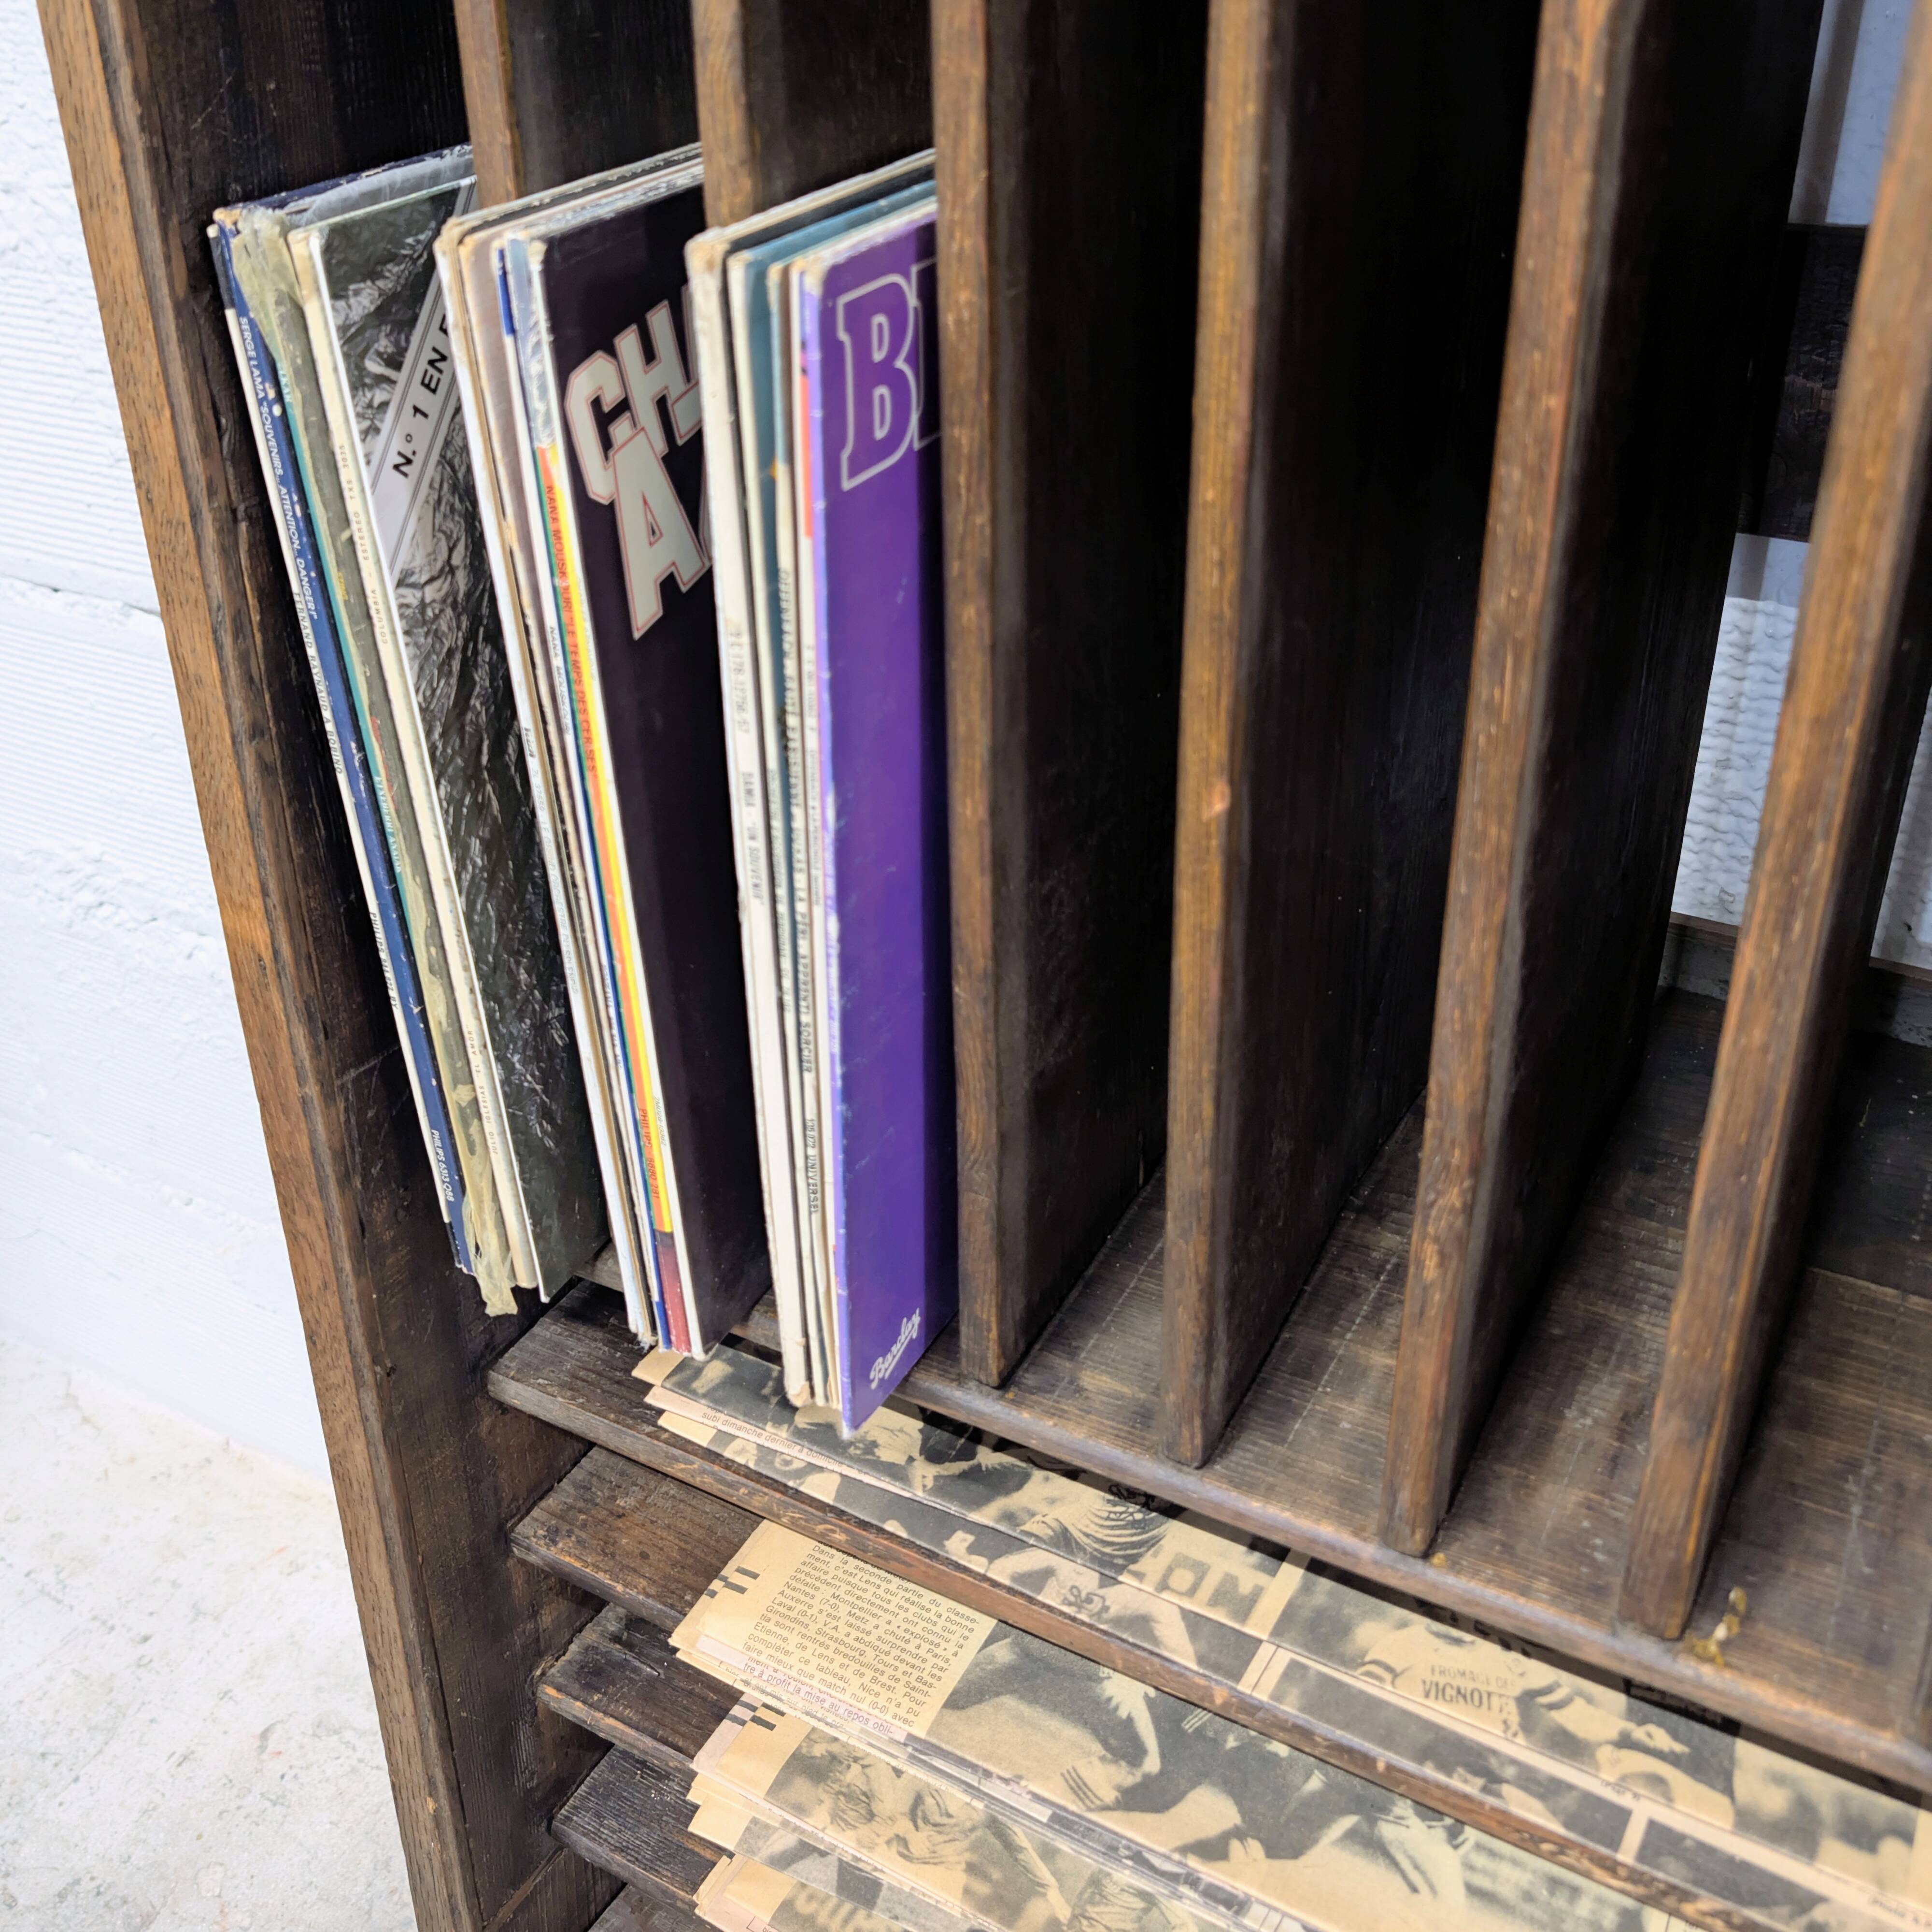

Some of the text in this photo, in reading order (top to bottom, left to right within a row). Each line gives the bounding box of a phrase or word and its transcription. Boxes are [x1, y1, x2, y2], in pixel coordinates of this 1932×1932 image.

[412, 404, 429, 420] 1
[421, 346, 448, 396] EN
[239, 315, 256, 357] SERGE
[249, 359, 266, 399] LAMA
[278, 485, 302, 557] ATTENTION...
[295, 557, 317, 620] DANGER!"
[339, 444, 388, 645] COLUMBIA ESTEREO TXS 3035
[612, 425, 712, 640] A
[545, 485, 559, 523] NANA
[569, 643, 583, 687] TEMPS
[576, 690, 587, 715] DES
[292, 591, 344, 774] FERNAND RAYNAUD A BOBINO
[549, 626, 560, 658] NANA
[369, 911, 385, 954] PHILIPS
[800, 1021, 812, 1073] SORCIER
[478, 1085, 492, 1124] IGLESIAS
[488, 1131, 498, 1155] JULIO
[431, 1128, 445, 1162] PHILIPS
[439, 1161, 449, 1182] 6313
[639, 1107, 659, 1199] PHILIPS 6680 281
[870, 1307, 921, 1390] Barclay
[701, 1410, 721, 1424] subi
[721, 1416, 764, 1441] dimanche
[764, 1432, 798, 1453] dernier
[783, 1581, 815, 1600] Nantes
[819, 1597, 839, 1613] (7-0),
[846, 1609, 869, 1625] Metz
[883, 1629, 911, 1645] chuté
[925, 1647, 951, 1666] Paris,
[789, 1574, 820, 1591] défaite
[829, 1591, 882, 1620] Montpellier
[903, 1628, 941, 1648] explosé
[800, 1560, 969, 1641] affaire puisque tous les clubs qui le
[806, 1553, 830, 1568] ment,
[834, 1565, 857, 1578] c'est
[858, 1574, 881, 1589] Lens
[883, 1588, 899, 1597] qui
[900, 1595, 931, 1613] réalise
[933, 1610, 942, 1619] la
[944, 1615, 974, 1633] bonne
[812, 1545, 835, 1559] Dans
[839, 1557, 848, 1565] la
[853, 1564, 892, 1584] seconde
[895, 1584, 923, 1599] partie
[928, 1599, 941, 1607] du
[946, 1607, 979, 1624] classe-
[844, 1589, 899, 1618] directement
[902, 1617, 918, 1628] ont
[922, 1626, 951, 1643] connu
[954, 1640, 964, 1649] la
[753, 1621, 927, 1707] Etienne, de Lens et de Brest. Pour
[759, 1613, 931, 1697] tia sont rentrés bredouilles de Saint-
[766, 1605, 937, 1689] Girondins, Strasbourg, Tours et Bas-
[771, 1596, 796, 1612] Laval
[796, 1608, 818, 1624] (0-1),
[823, 1619, 840, 1633] V.A.
[852, 1635, 891, 1657] abdiqué
[893, 1655, 925, 1674] devant
[927, 1670, 942, 1681] les
[777, 1589, 949, 1673] Auxerre s'est laissé surprendre par
[742, 1641, 767, 1657] faire
[766, 1654, 794, 1671] mieux
[796, 1668, 815, 1680] que
[818, 1677, 846, 1695] match
[850, 1692, 866, 1704] nul
[868, 1700, 889, 1716] (0-0)
[891, 1712, 914, 1727] avec
[742, 1662, 757, 1674] tre
[765, 1672, 793, 1692] profit
[792, 1684, 804, 1694] la
[803, 1689, 827, 1705] mise
[827, 1701, 842, 1712] au
[841, 1707, 871, 1727] repos
[871, 1719, 895, 1737] obli-
[748, 1633, 795, 1657] compléter
[798, 1656, 810, 1665] ce
[815, 1662, 851, 1687] tableau,
[858, 1681, 881, 1698] Nice
[885, 1697, 901, 1708] n'a
[905, 1706, 920, 1717] pu
